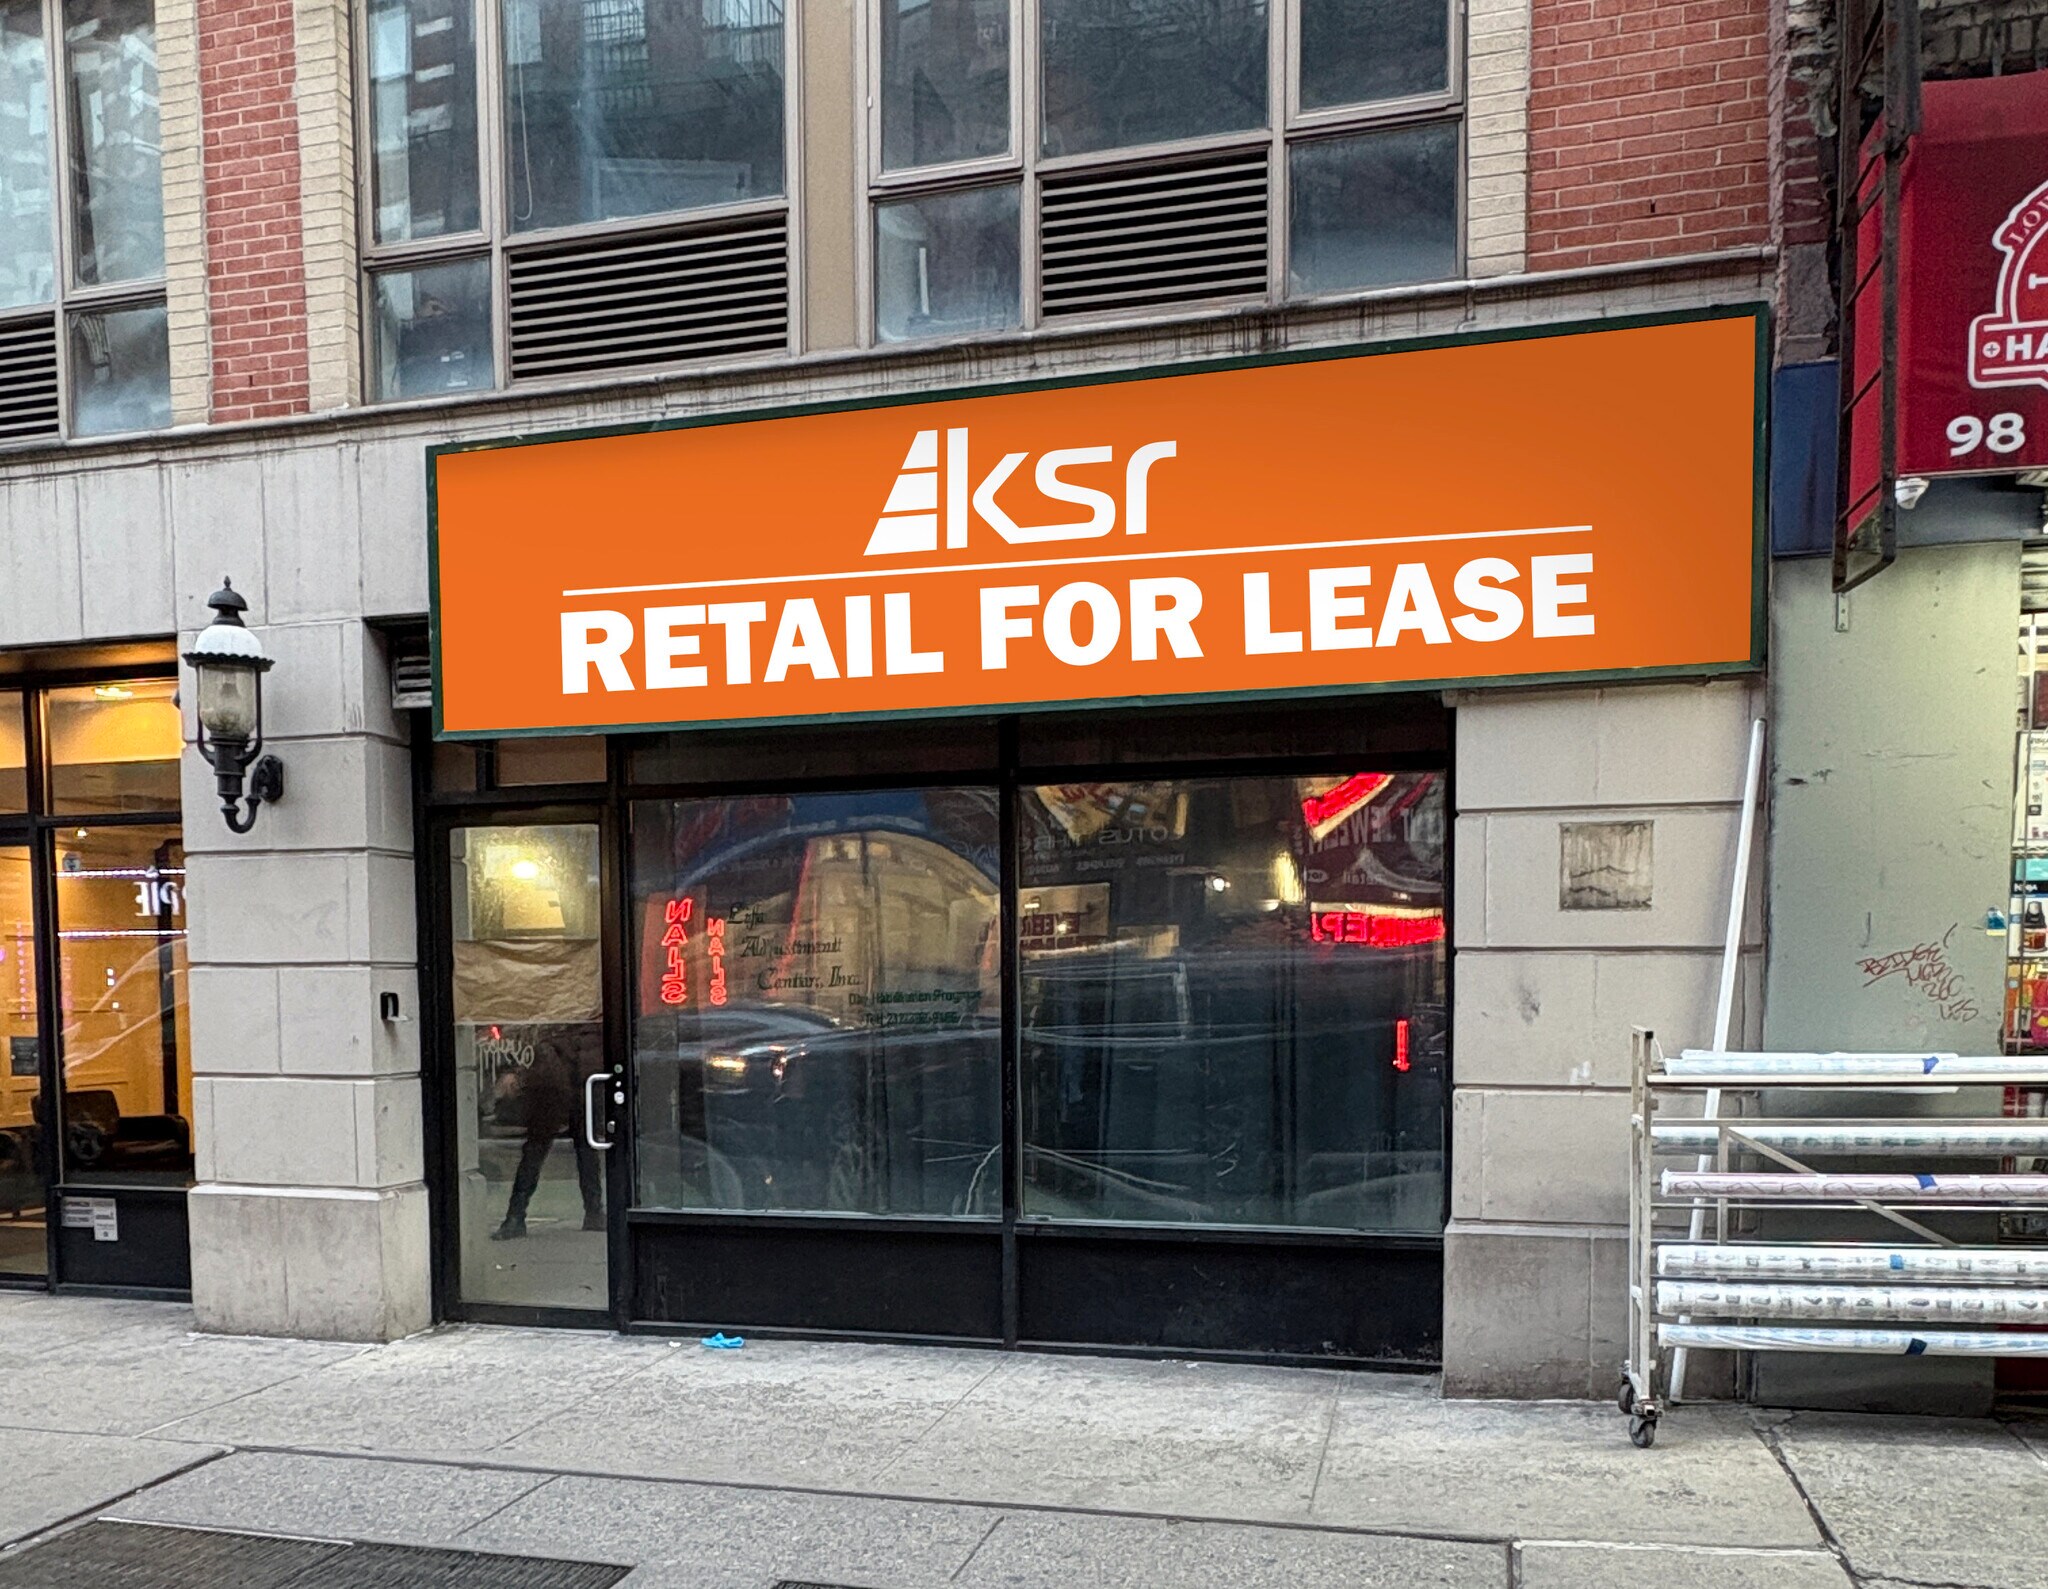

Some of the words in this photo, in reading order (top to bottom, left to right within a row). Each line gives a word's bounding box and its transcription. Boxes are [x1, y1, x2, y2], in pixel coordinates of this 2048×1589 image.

[1946, 411, 2026, 457] 98
[560, 591, 945, 695] RETAIL
[979, 576, 1205, 671] FOR
[1243, 552, 1595, 656] LEASE
